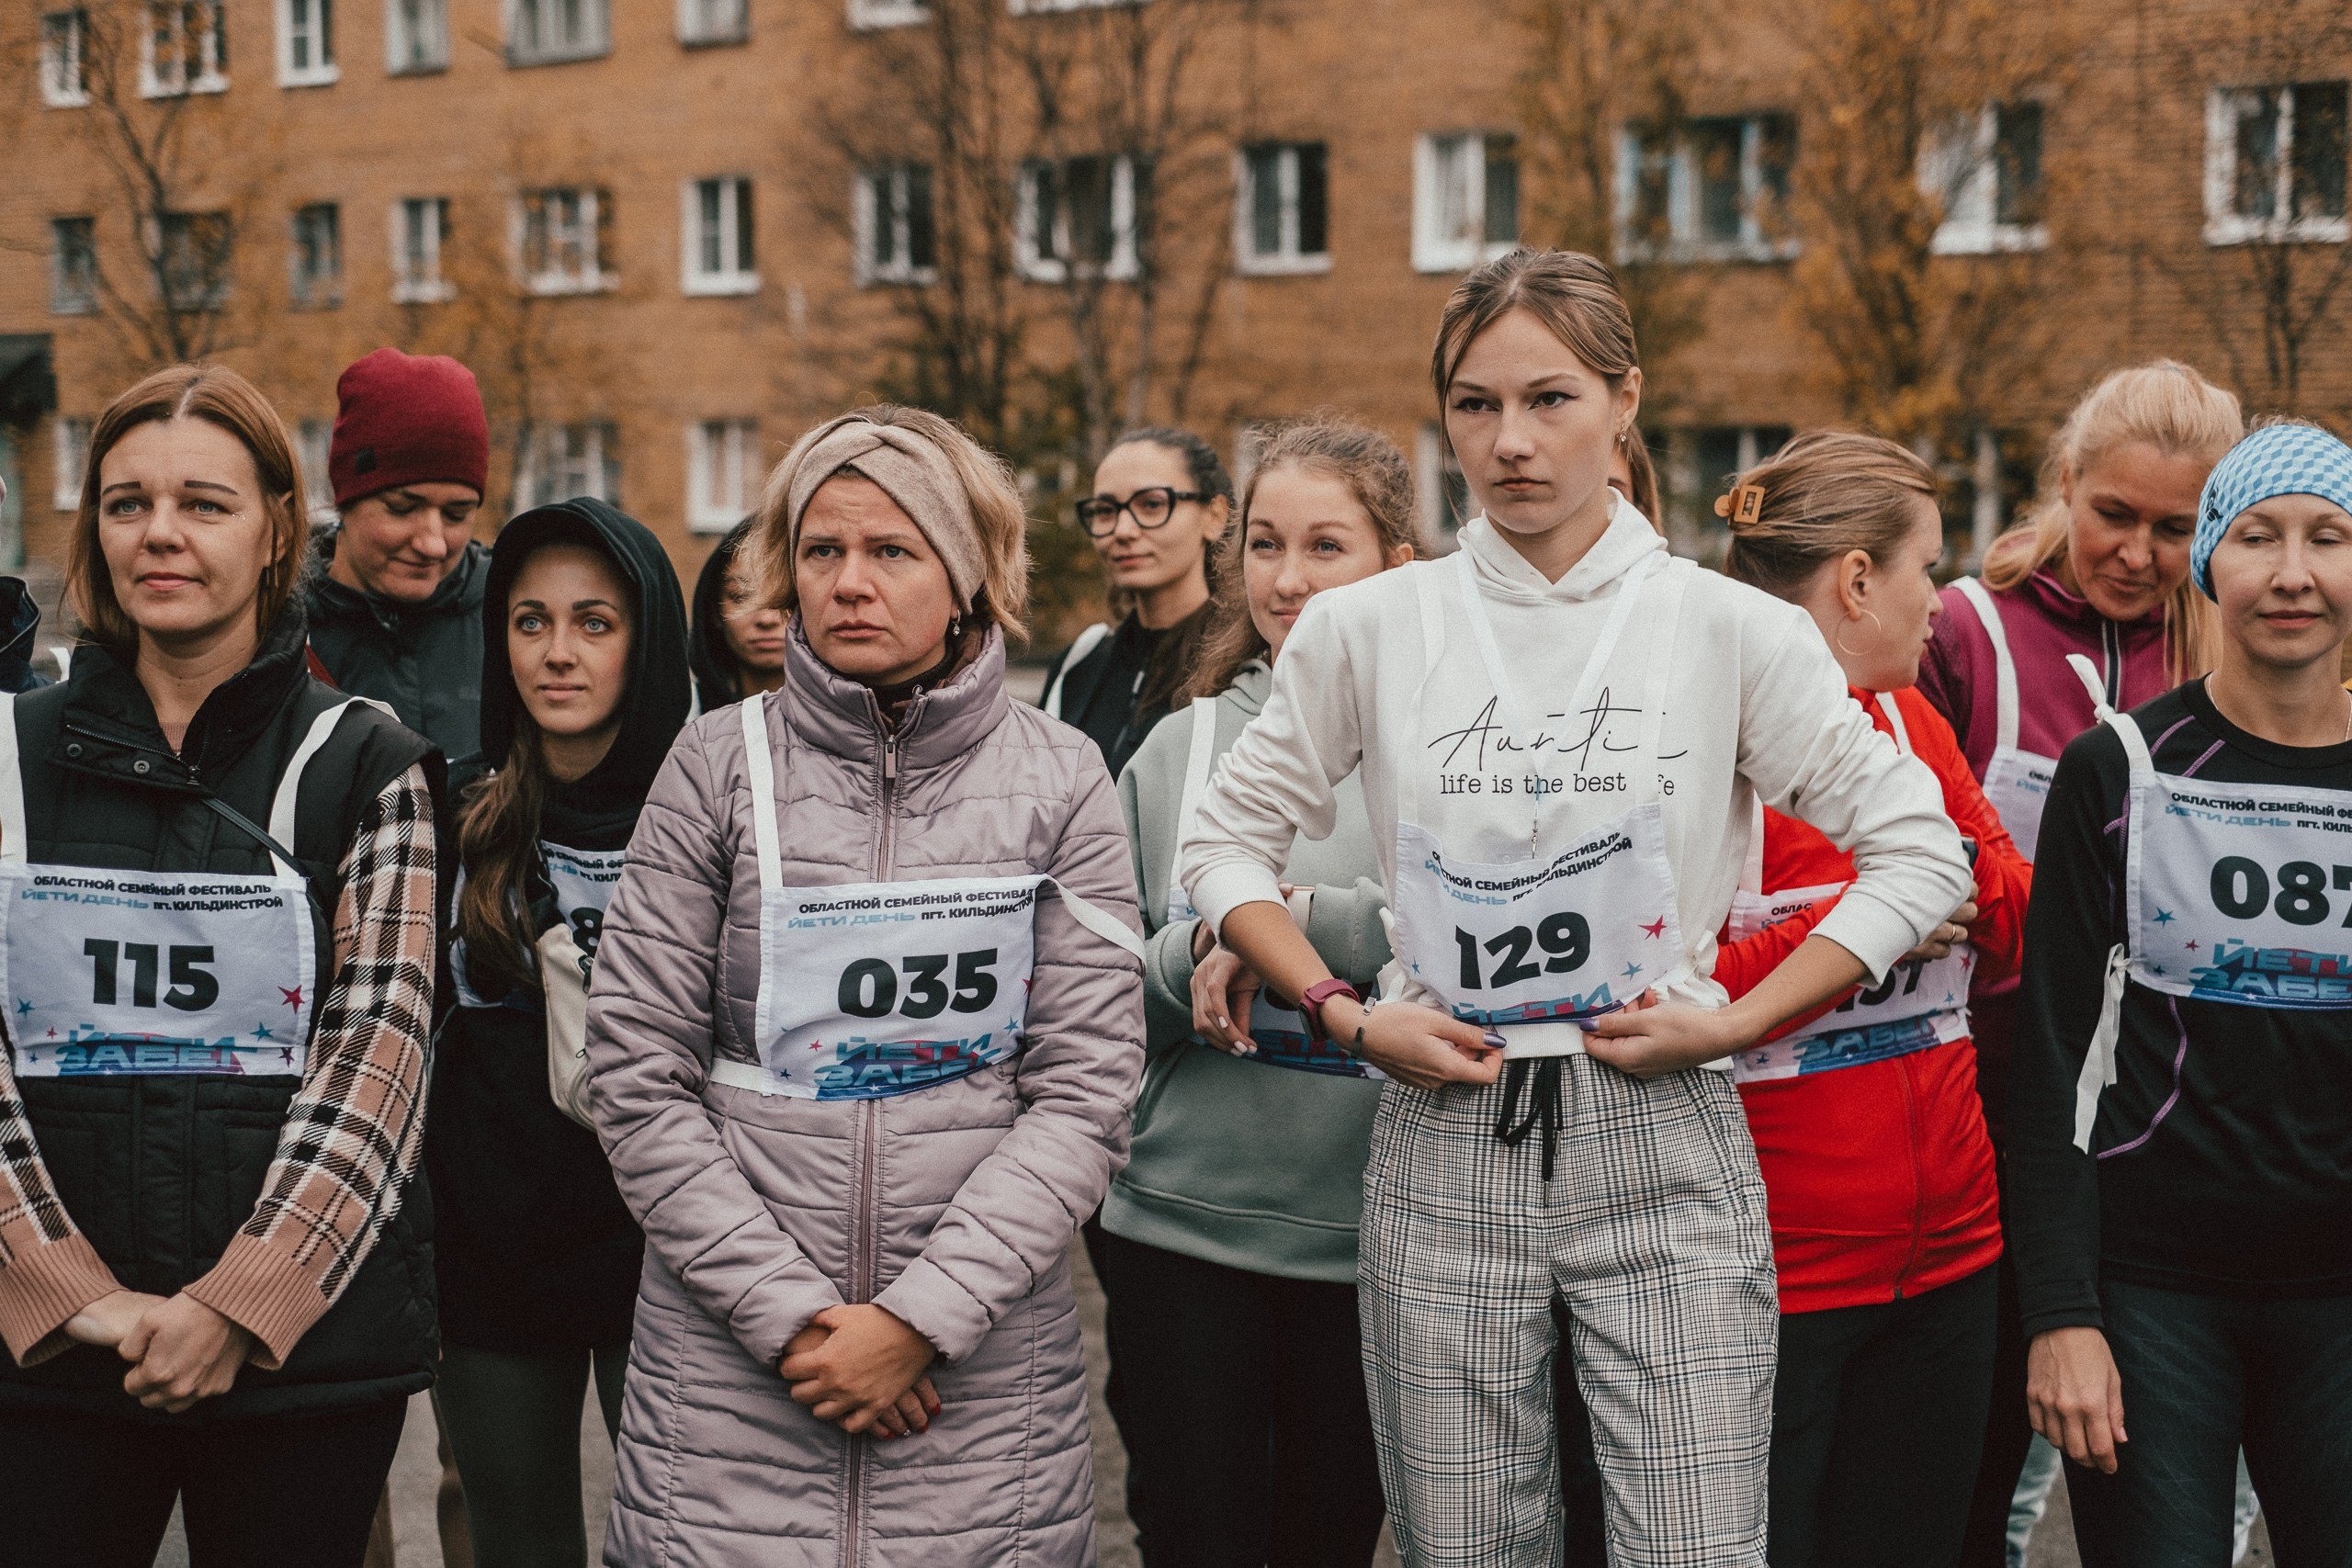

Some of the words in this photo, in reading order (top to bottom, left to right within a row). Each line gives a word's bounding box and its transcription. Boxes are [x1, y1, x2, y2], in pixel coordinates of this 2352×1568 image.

[1440, 774, 1482, 795] life
[1491, 775, 1513, 793] is
[1523, 775, 1564, 795] the
[1574, 773, 1627, 792] best
[2165, 805, 2222, 823] ЙЕТИ
[2225, 814, 2291, 828] ДЕНЬ
[2171, 792, 2256, 812] ОБЛАСТНОЙ
[2258, 801, 2335, 818] СЕМЕЙНЫЙ
[33, 875, 115, 891] ОБЛАСТНОЙ
[187, 884, 272, 896] ФЕСТИВАЛЬ
[1451, 888, 1508, 906] ДЕНЬ
[21, 888, 79, 902] ЙЕТИ
[81, 893, 150, 909] ДЕНЬ
[173, 897, 284, 912] КИЛЬДИНСТРОЙ
[798, 897, 881, 915] ОБЛАСТНОЙ
[884, 891, 963, 908] СЕМЕЙНЫЙ
[787, 915, 847, 930] ЙЕТИ
[850, 912, 916, 927] ДЕНЬ
[921, 910, 946, 920] пгт.
[1455, 911, 1591, 990] 129
[84, 938, 220, 1012] 115
[837, 947, 999, 1020] 035
[2188, 966, 2352, 1000] ЗАБЕ
[836, 1032, 993, 1062] ЙЕТИ
